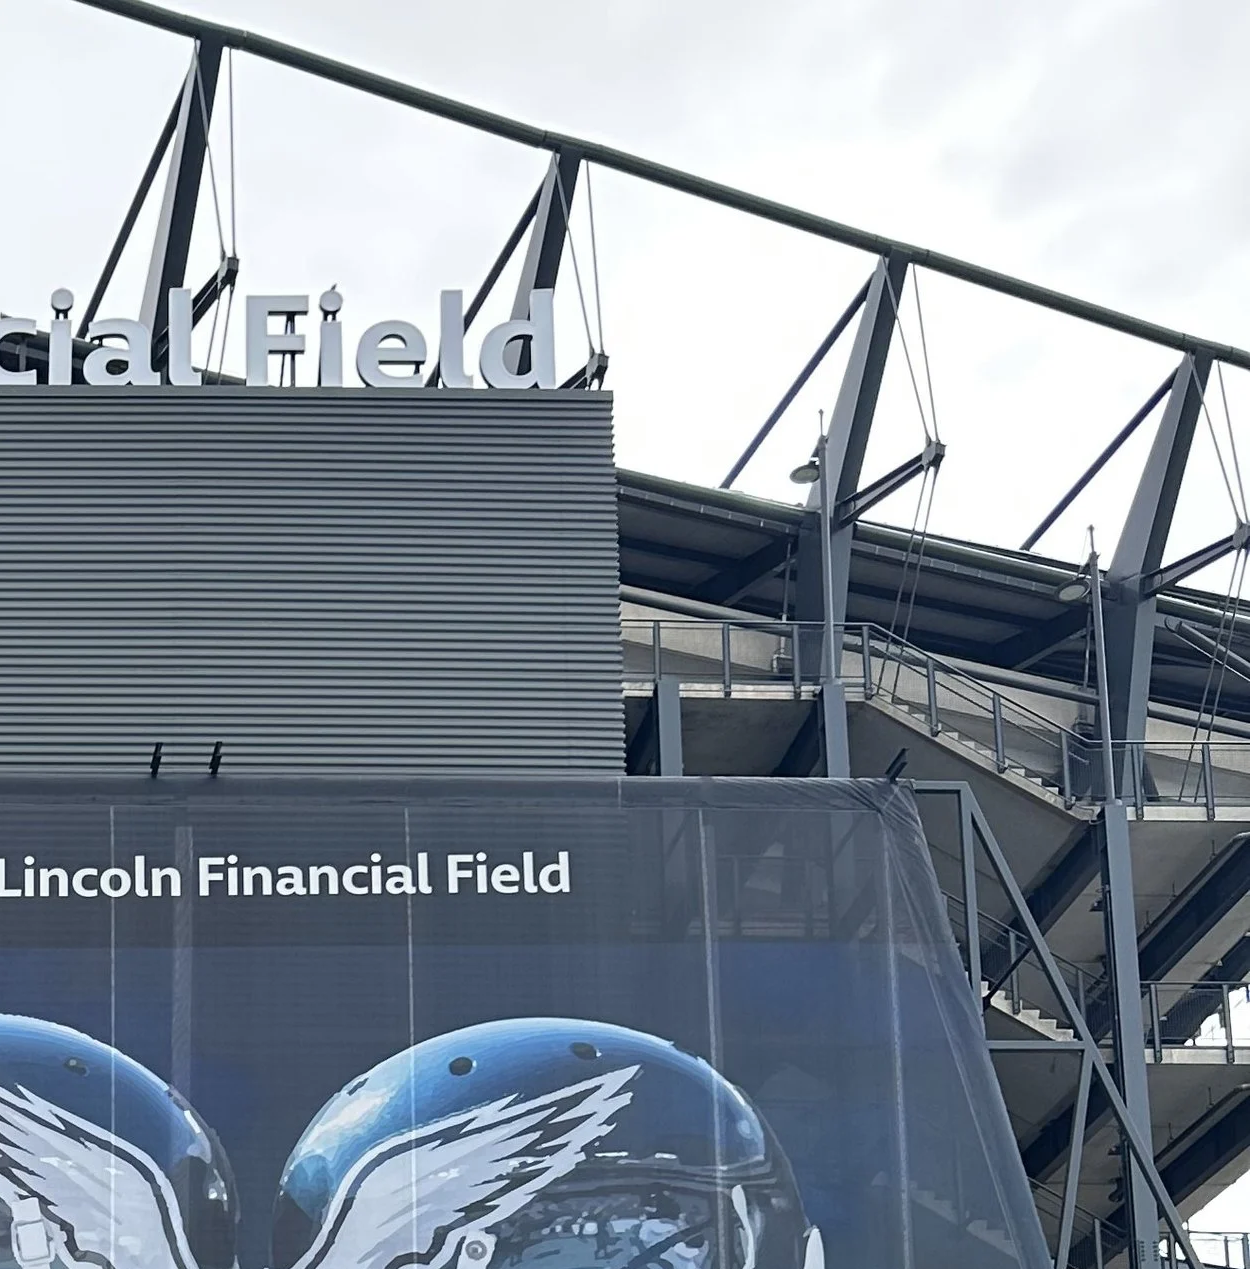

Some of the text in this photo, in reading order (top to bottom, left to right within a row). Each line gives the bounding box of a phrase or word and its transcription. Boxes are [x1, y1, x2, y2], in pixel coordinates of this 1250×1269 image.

[246, 285, 558, 390] Field
[198, 852, 433, 897] Financial
[446, 851, 572, 894] Field
